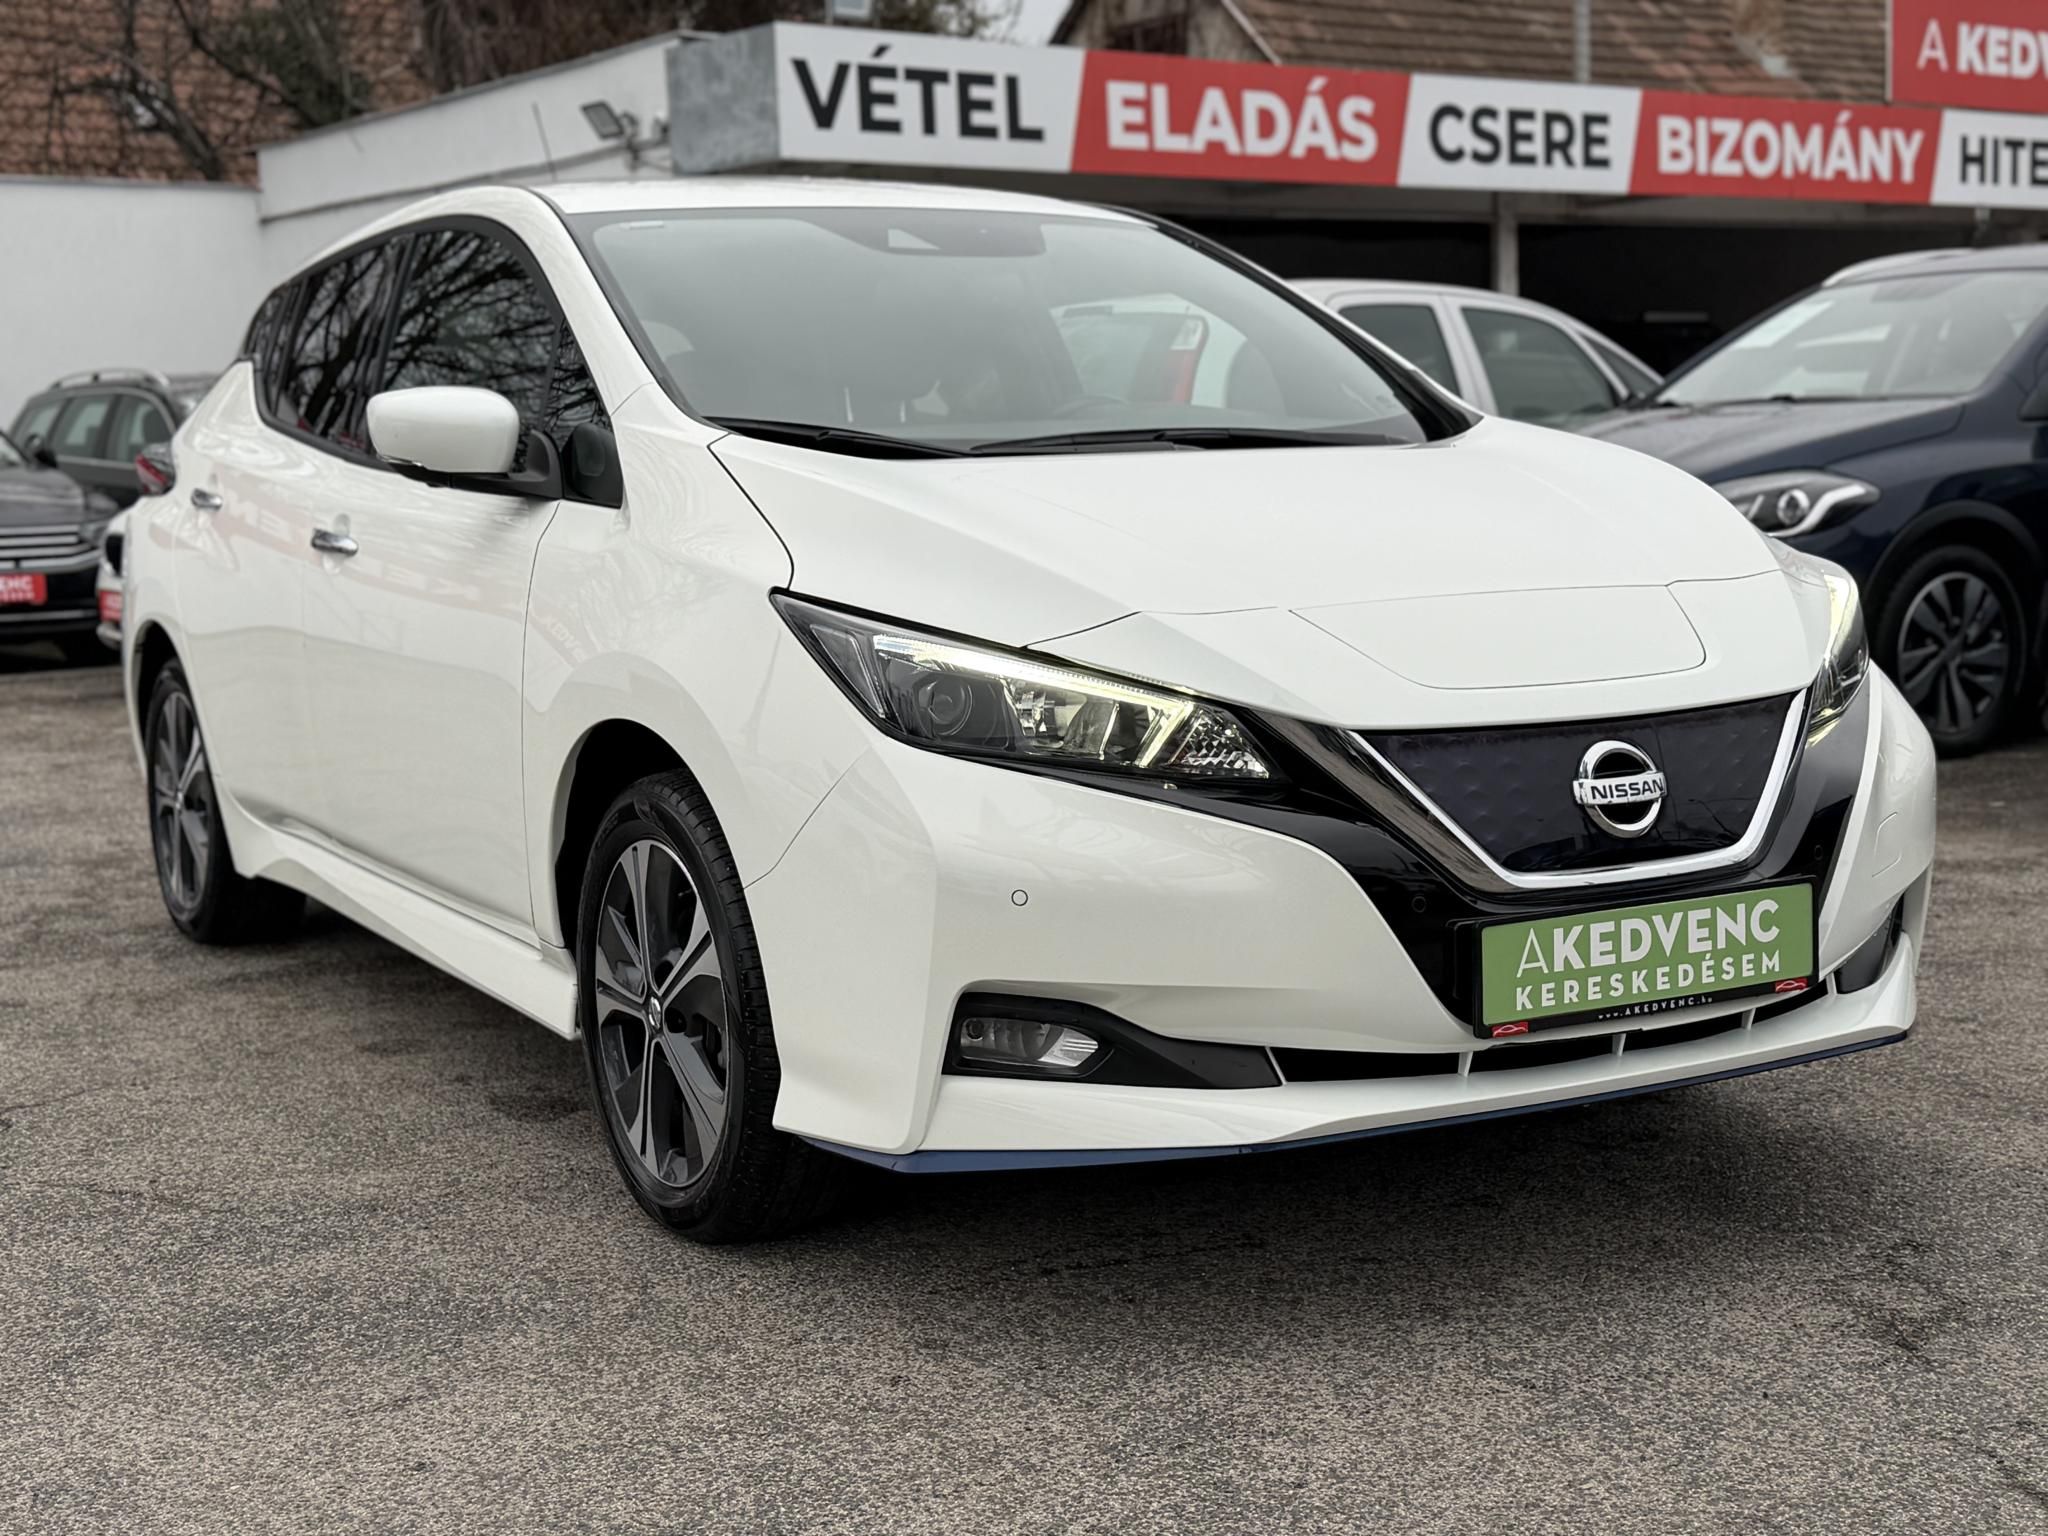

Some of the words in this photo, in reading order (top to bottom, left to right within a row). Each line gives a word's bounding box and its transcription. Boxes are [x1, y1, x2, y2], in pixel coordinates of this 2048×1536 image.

[1916, 18, 1949, 71] A
[791, 45, 1044, 142] VÉTEL
[1105, 75, 1378, 163] ELADÁS
[1430, 104, 1611, 169] CSERE
[1657, 111, 1924, 184] BIZOMÁNY
[1591, 777, 1664, 800] NISSAN
[1516, 950, 1780, 1011] KERESKEDÉSEM
